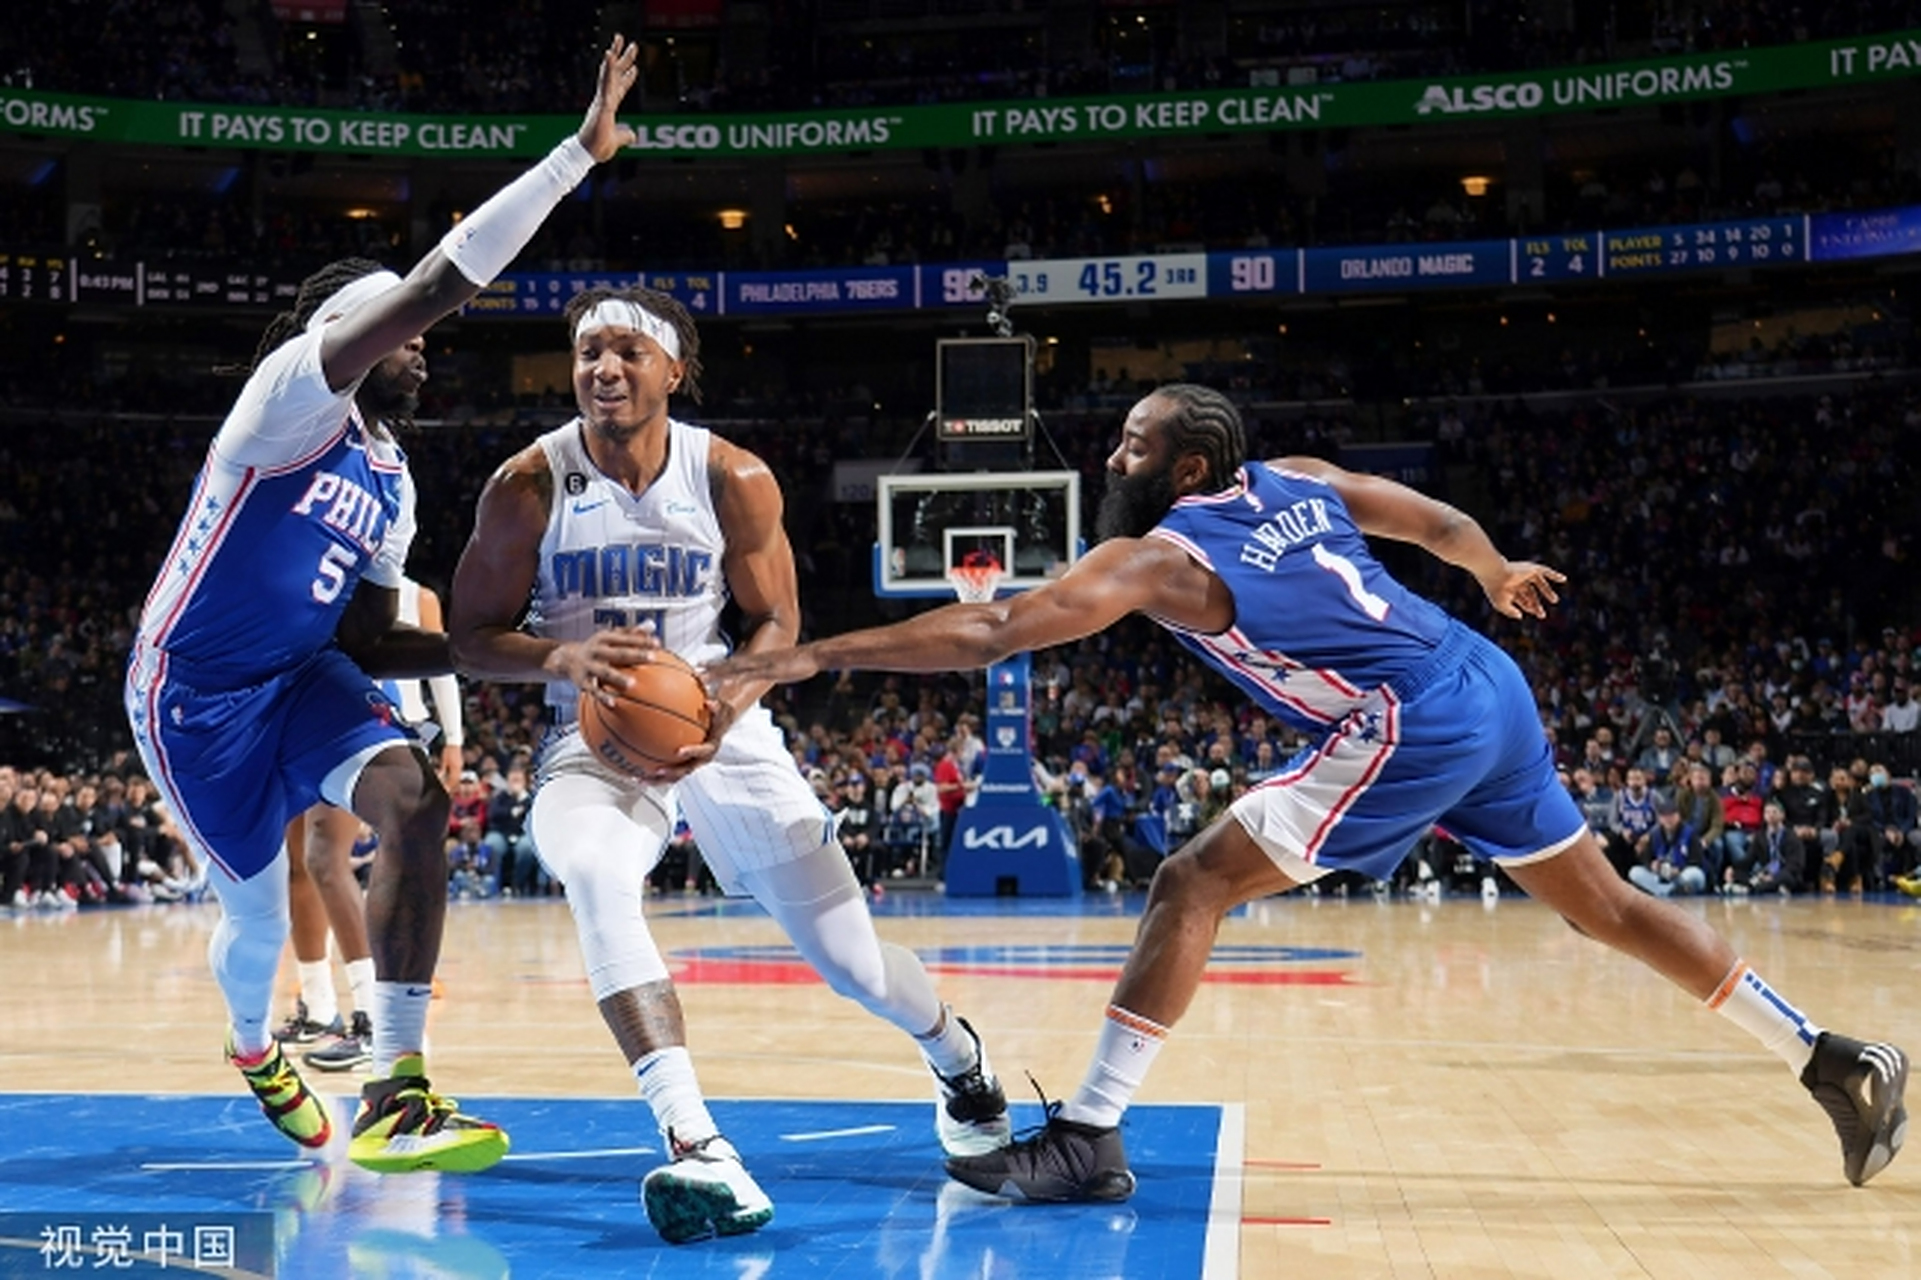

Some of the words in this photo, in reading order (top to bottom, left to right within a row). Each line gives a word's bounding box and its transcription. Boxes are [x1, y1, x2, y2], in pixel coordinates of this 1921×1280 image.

[1830, 47, 1858, 76] IT
[1417, 82, 1543, 114] ALSCO
[0, 99, 96, 131] ORMS
[180, 112, 204, 138] IT
[212, 114, 284, 142] PAYS
[290, 118, 331, 144] TO
[340, 121, 410, 147] KEEP
[973, 111, 997, 136] IT
[1006, 107, 1077, 134] PAYS
[1085, 105, 1127, 131] TO
[1136, 100, 1209, 128] KEEP
[616, 123, 721, 149] LSCO
[1079, 261, 1156, 296] 45.2
[1231, 257, 1274, 290] 90
[1341, 257, 1412, 279] ORLANDO
[1418, 254, 1474, 276] MAGIC
[1530, 256, 1546, 277] 2
[1567, 254, 1585, 273] 4
[691, 291, 707, 311] 4
[740, 282, 839, 302] PHILADELPHIA
[846, 280, 898, 300] 76ERS
[967, 418, 1023, 433] TISSOT
[291, 471, 382, 556] PHIL
[312, 541, 359, 605] 5
[553, 543, 713, 598] MAGIC
[1311, 542, 1390, 624] 1
[964, 826, 1049, 849] KIA
